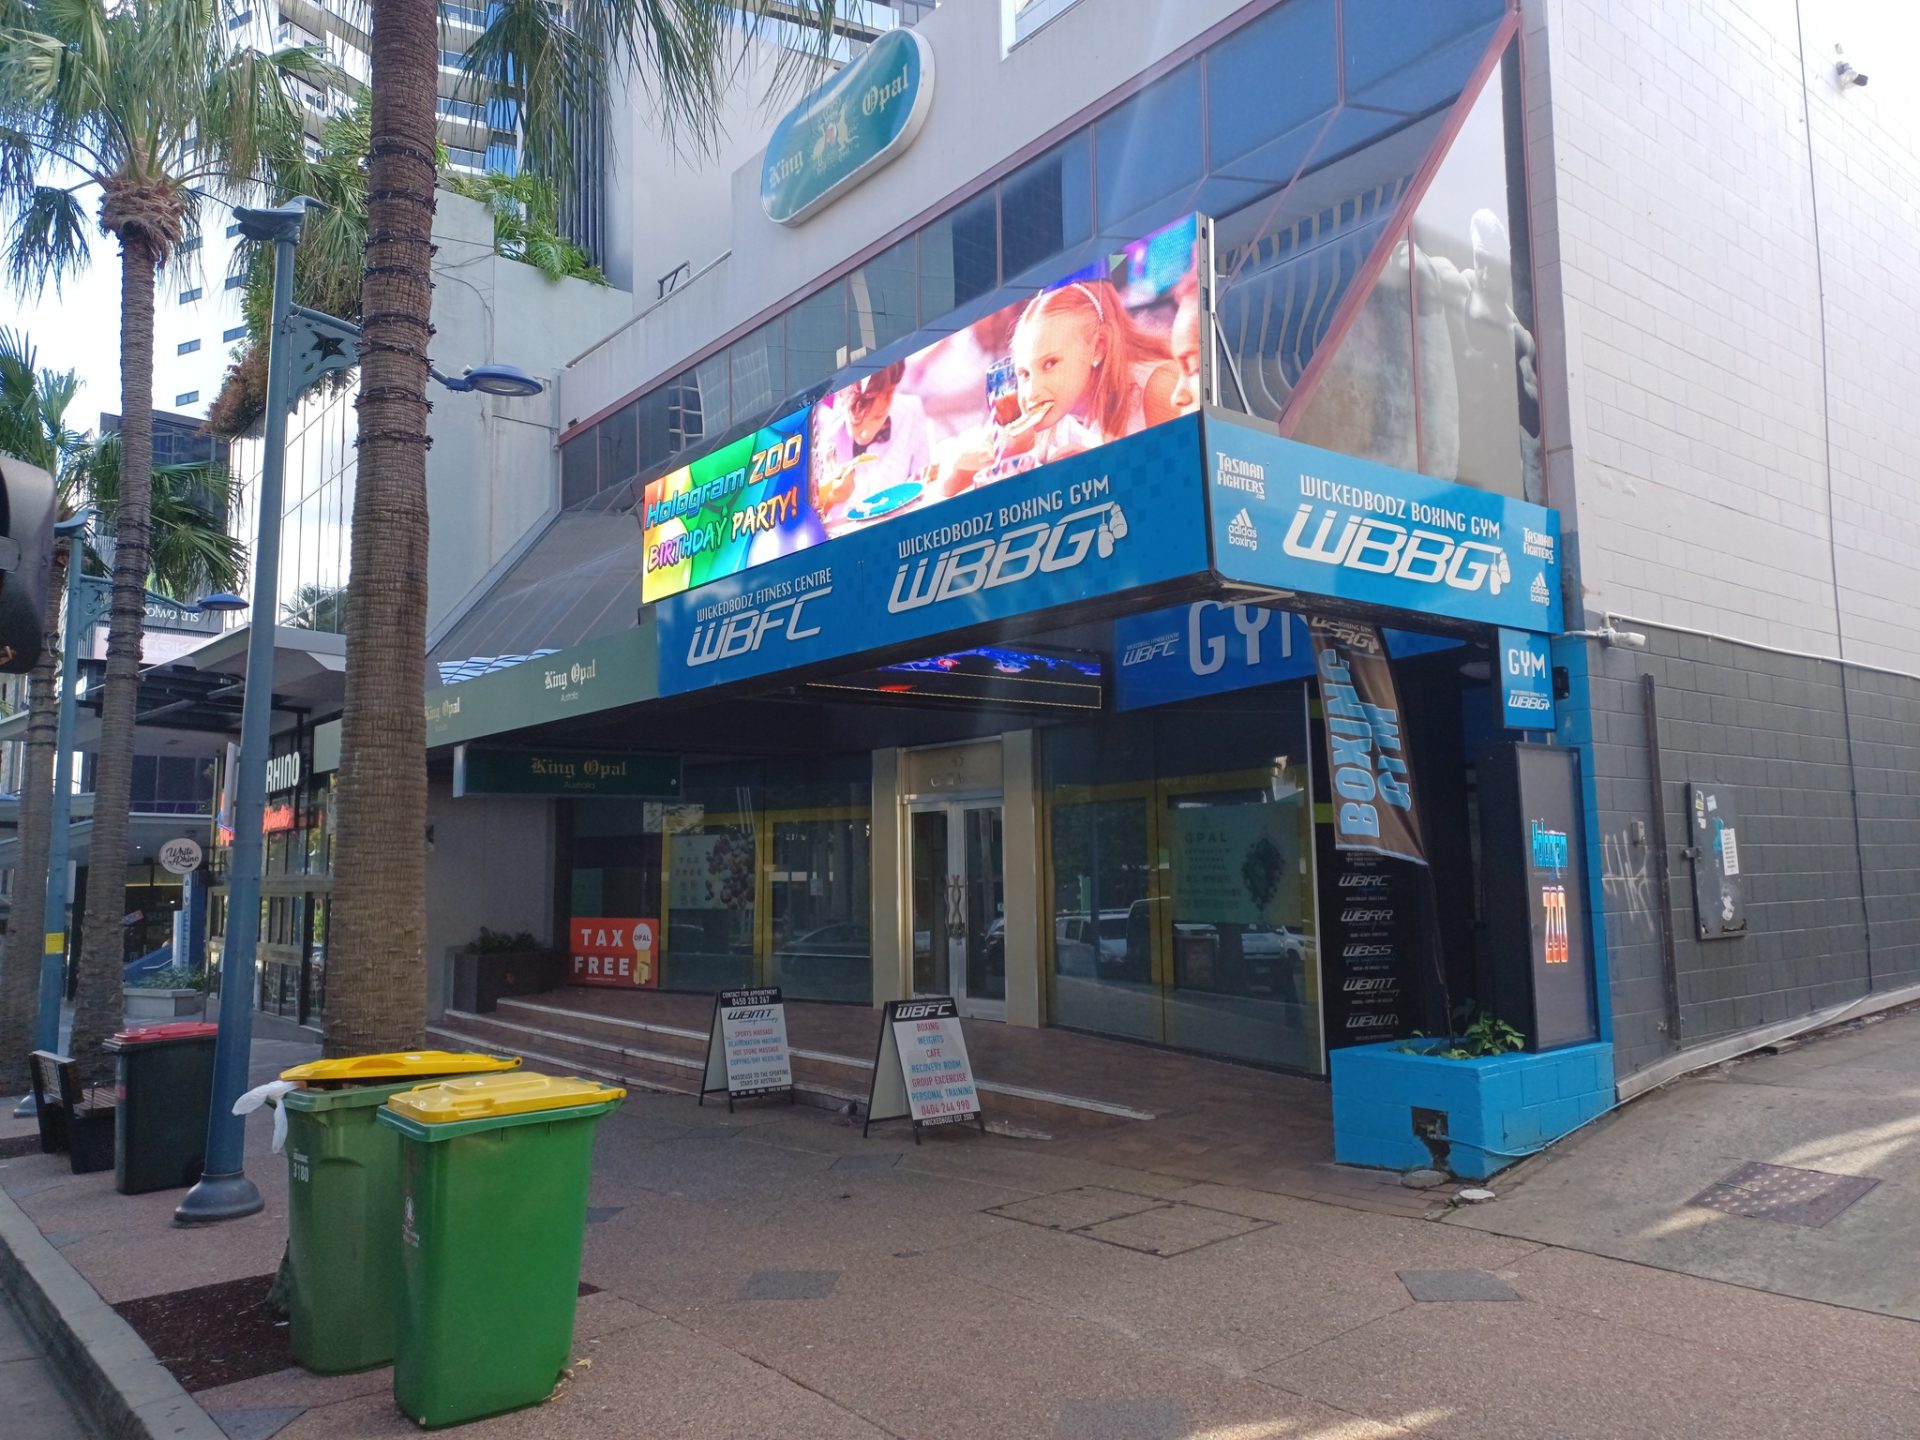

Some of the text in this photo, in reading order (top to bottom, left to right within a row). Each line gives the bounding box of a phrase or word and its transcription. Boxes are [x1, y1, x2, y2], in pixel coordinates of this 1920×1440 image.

[646, 434, 802, 530] Hologram ZOO
[898, 474, 1110, 559] WICKEDBODZ BOXING GYM
[1300, 474, 1500, 540] WICKEDBODZ BOXING GYM
[647, 485, 798, 572] BIRTHDAY PARTY!
[1228, 523, 1258, 538] adidas
[1228, 533, 1258, 551] boxing
[1282, 503, 1504, 592] WBBG
[887, 500, 1116, 614] WBBG
[697, 567, 832, 622] WICKEDBODZ FITNESS CENTRE
[686, 586, 833, 667] WBFC
[1122, 638, 1180, 667] WBFC
[1508, 648, 1546, 679] GYM
[544, 659, 596, 690] King Opal
[1318, 649, 1380, 838] BOXING
[265, 751, 300, 793] RHINO
[531, 757, 626, 779] King Opal
[1338, 875, 1392, 887] WBRC
[1340, 909, 1393, 922] WBRR
[581, 928, 624, 947] TAX
[634, 934, 650, 942] OPAL
[1342, 944, 1394, 957] WBSS
[574, 956, 630, 976] FREE
[1343, 977, 1397, 991] WBMT
[895, 1003, 952, 1019] WBFC
[916, 1022, 939, 1032] BOXING
[917, 1035, 944, 1045] WEIGHTS
[925, 1048, 942, 1058] CAFE
[911, 1060, 961, 1073] RECOVERY ROOM
[911, 1076, 933, 1087] GROUP
[911, 1086, 974, 1102] PERSONAL TRAINING
[921, 1099, 971, 1116] 0404 244 990
